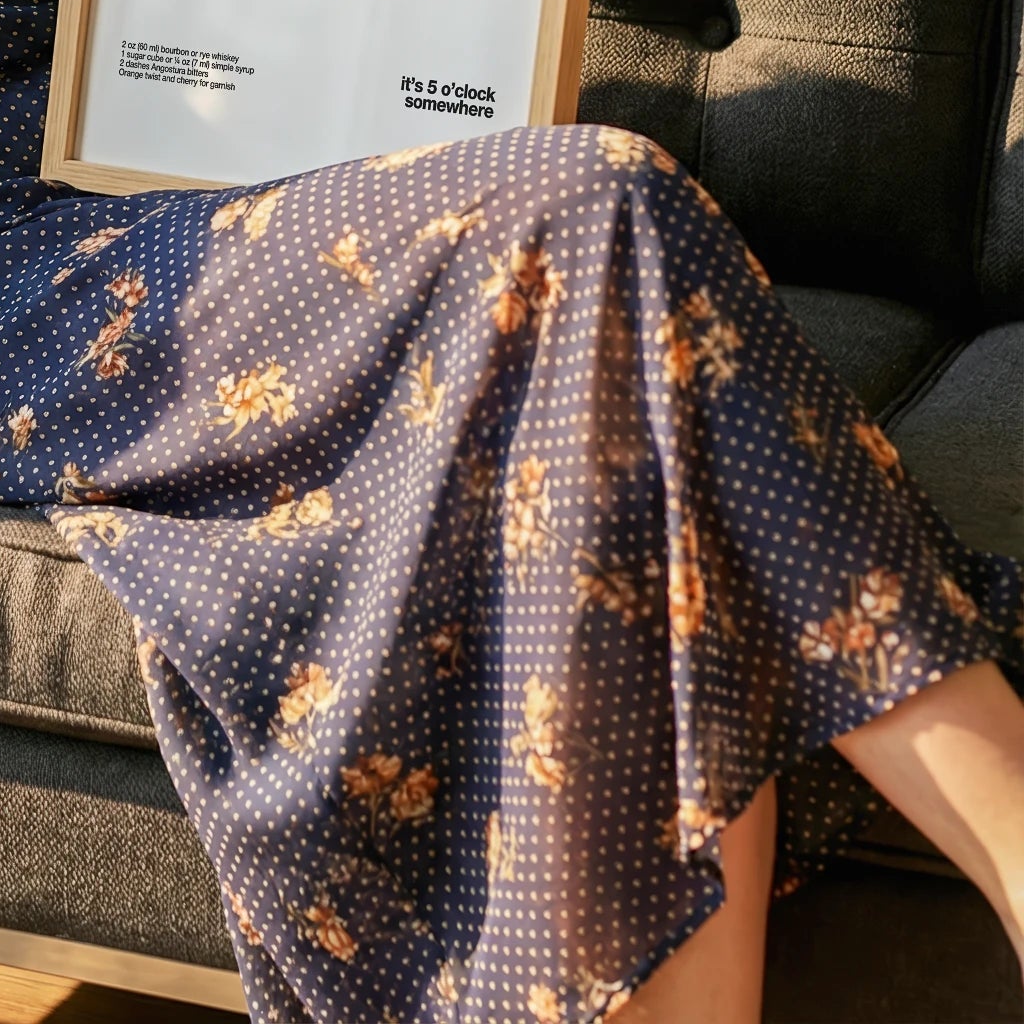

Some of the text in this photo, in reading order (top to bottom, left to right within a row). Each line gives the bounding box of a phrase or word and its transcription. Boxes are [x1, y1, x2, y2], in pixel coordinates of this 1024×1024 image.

[121, 40, 127, 48] 2
[137, 42, 148, 51] (60
[149, 44, 160, 53] ml)
[161, 45, 190, 56] bourbon
[199, 51, 210, 59] rye
[211, 52, 240, 64] whiskey
[121, 49, 125, 57] 1
[126, 51, 146, 60] sugar
[146, 53, 164, 62] cube
[192, 58, 199, 67] (7
[199, 60, 210, 69] ml)
[211, 62, 234, 72] simple
[235, 66, 255, 75] syrup
[118, 68, 236, 91] Orange twist and cherry for garnish
[125, 60, 150, 70] dashes
[151, 63, 185, 74] Angostura
[187, 67, 209, 78] bitters
[400, 75, 496, 103] it’s 5 o’clock
[404, 96, 495, 119] somewhere
